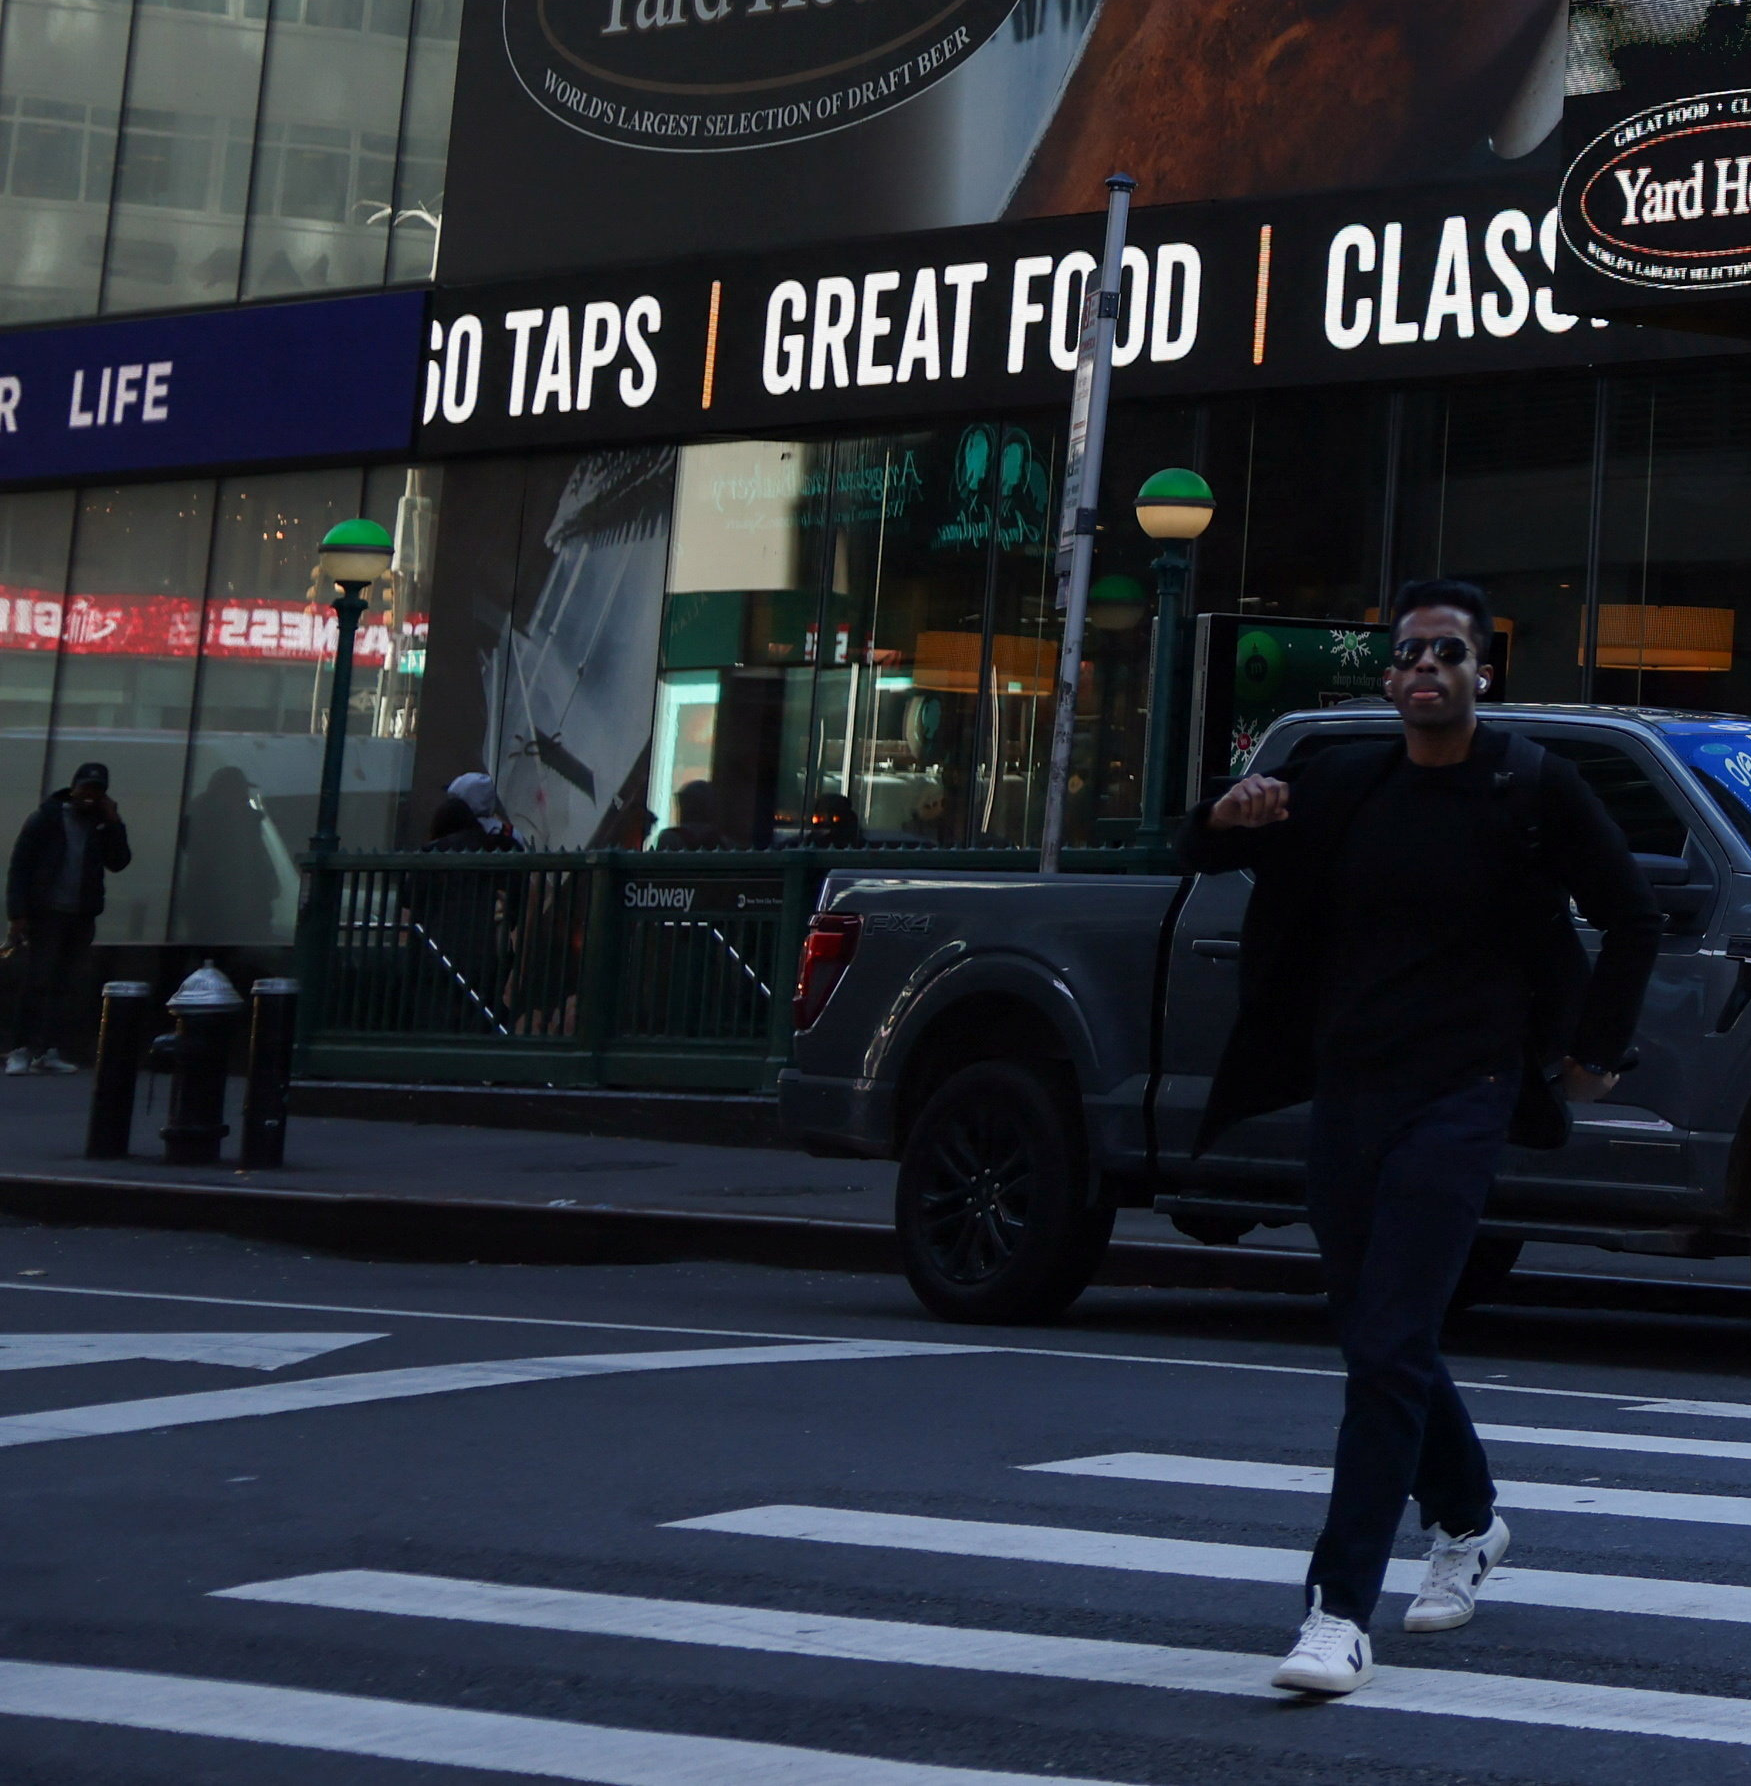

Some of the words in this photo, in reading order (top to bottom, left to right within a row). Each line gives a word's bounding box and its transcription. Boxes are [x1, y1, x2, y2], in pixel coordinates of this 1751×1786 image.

[542, 67, 616, 125] WORLD'S
[616, 105, 702, 138] LARGEST
[703, 101, 813, 137] SELECTION
[815, 91, 845, 120] OF
[846, 61, 913, 111] DRAFT
[916, 24, 972, 78] BEER
[1613, 113, 1665, 148] GREAT
[1666, 102, 1711, 127] FOOD
[1612, 158, 1706, 227] Yard
[504, 294, 663, 417] TAPS
[761, 261, 988, 396] GREAT
[1007, 241, 1202, 374] FOOD
[1323, 206, 1581, 351] CLAS
[68, 360, 174, 429] LIFE
[623, 881, 695, 912] Subway
[863, 913, 933, 937] FX4
